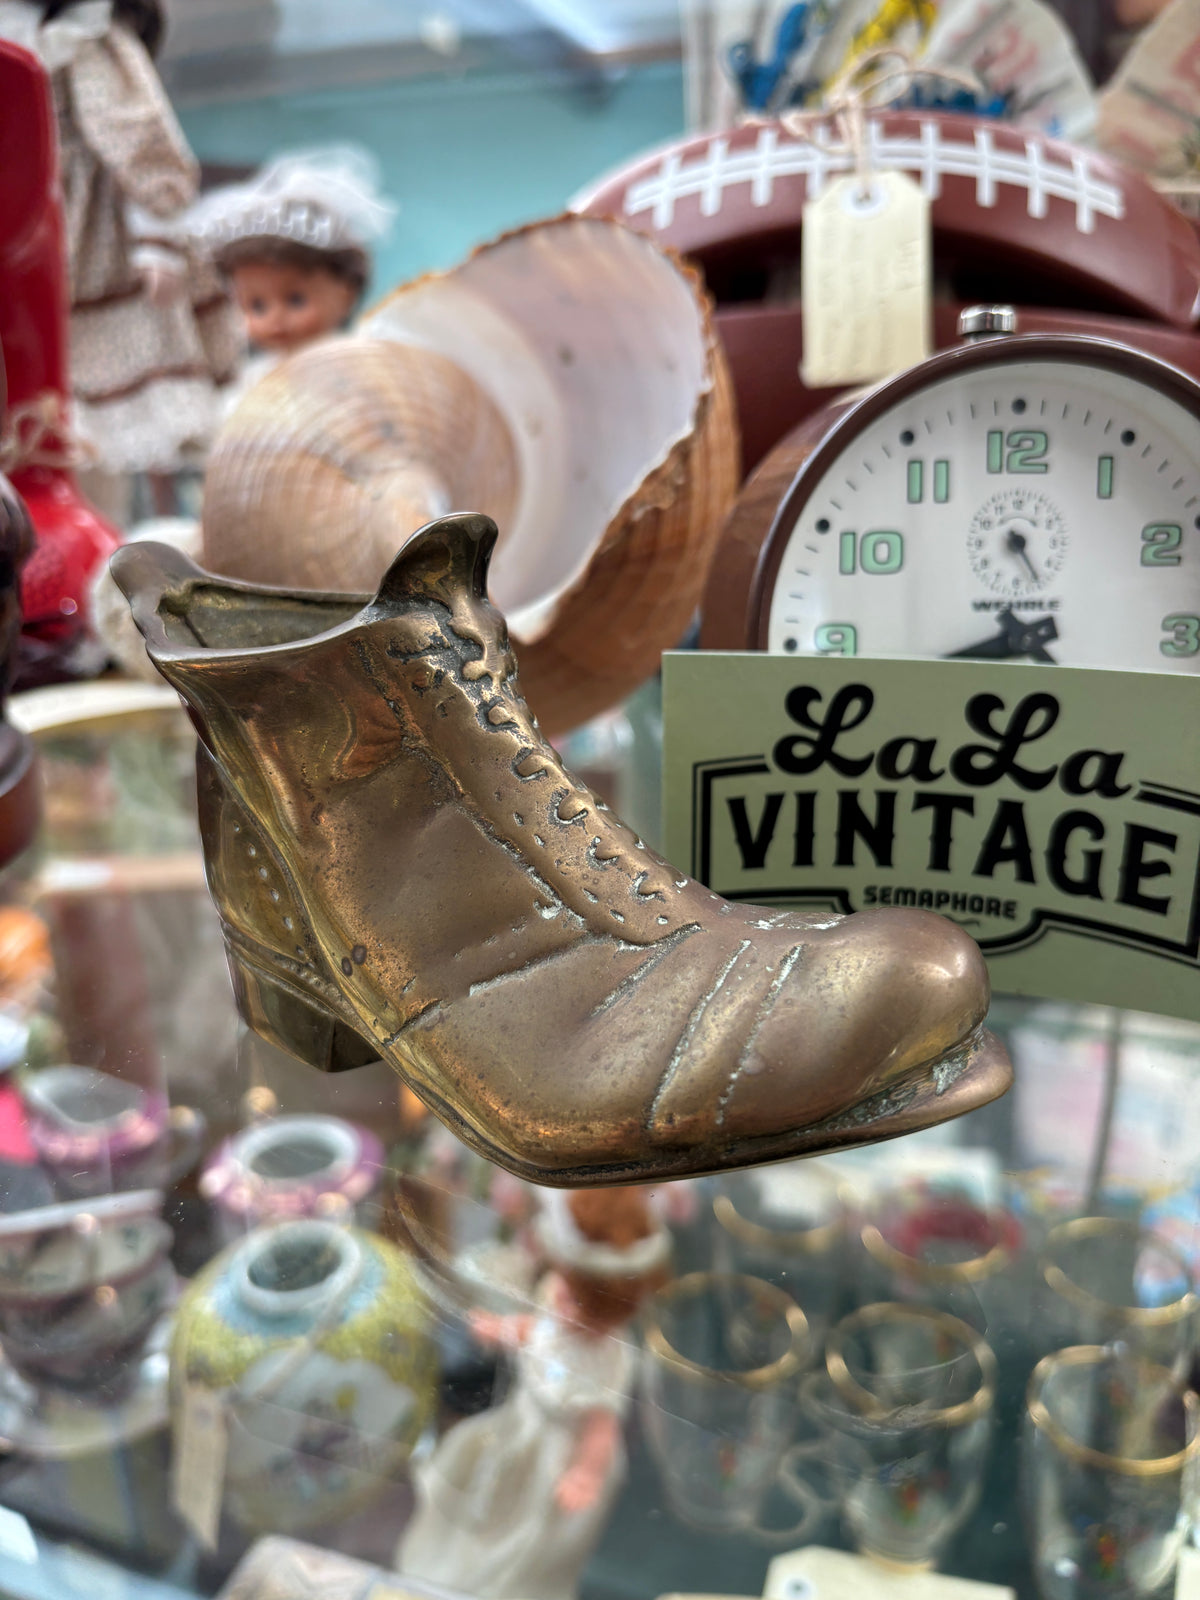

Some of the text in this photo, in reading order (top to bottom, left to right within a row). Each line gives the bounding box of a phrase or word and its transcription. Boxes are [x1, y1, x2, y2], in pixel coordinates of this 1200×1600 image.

[987, 431, 1048, 473] 12
[906, 460, 949, 503] 11
[1098, 456, 1113, 499] 1
[839, 531, 904, 575] 10
[1140, 524, 1182, 567] 2
[1159, 614, 1200, 658] 3
[726, 789, 1178, 917] VINTAGE
[863, 884, 1017, 921] SEMAPHORE
